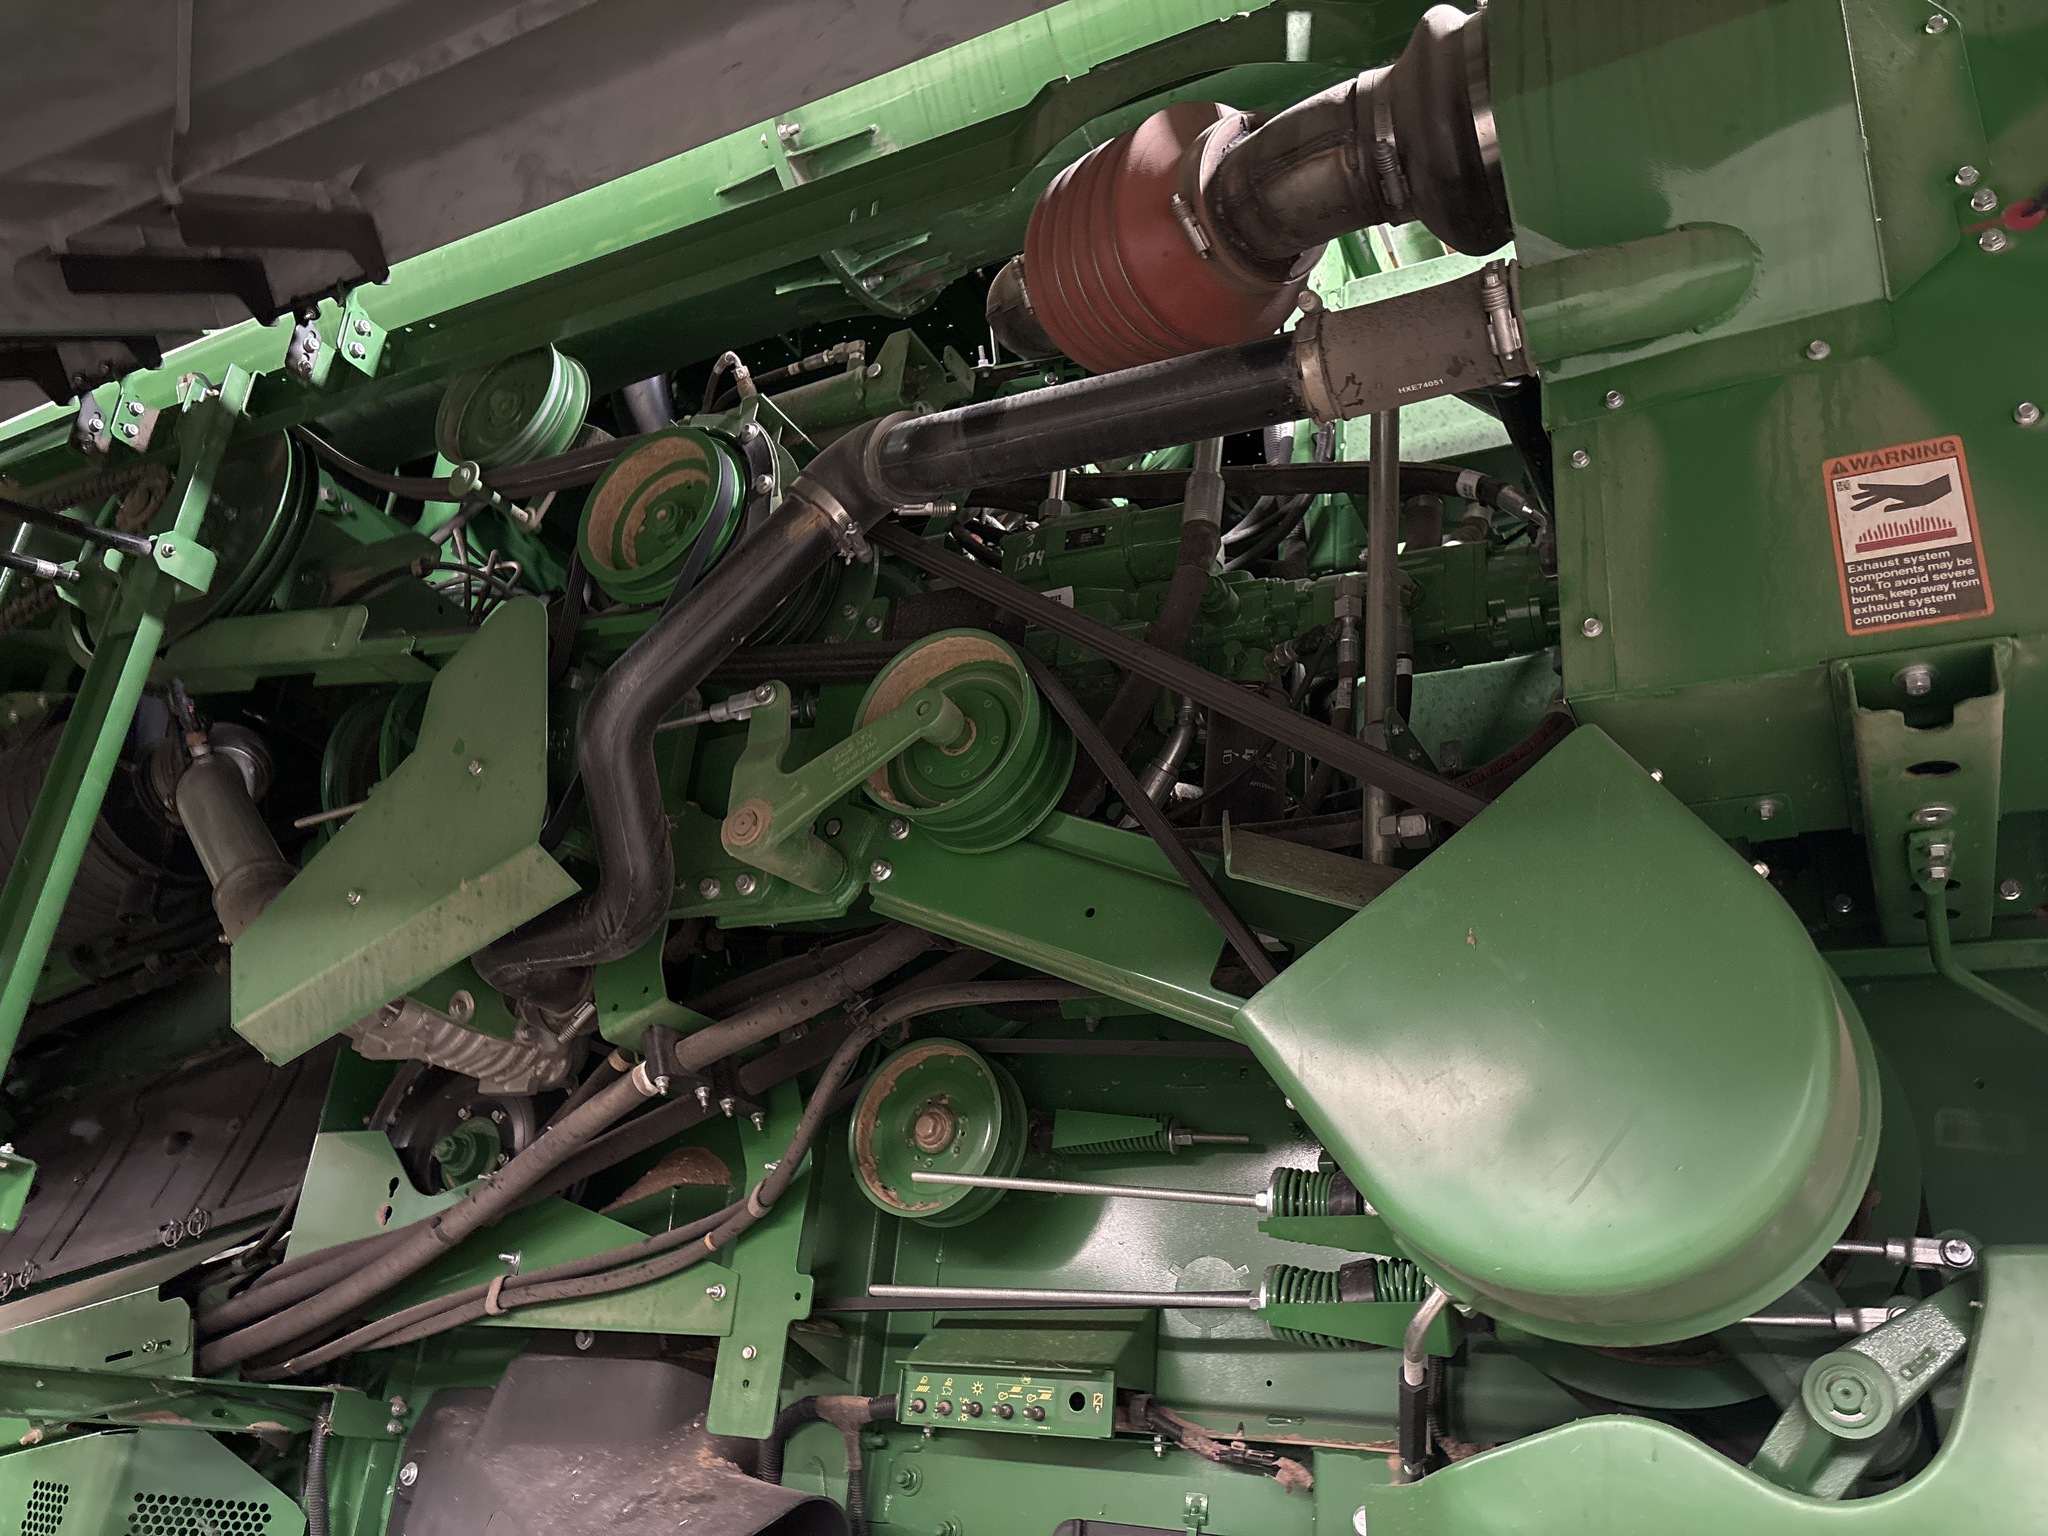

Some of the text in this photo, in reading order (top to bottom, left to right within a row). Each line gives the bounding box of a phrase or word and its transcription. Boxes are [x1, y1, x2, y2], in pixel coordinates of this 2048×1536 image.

[1398, 378, 1444, 394] HXE74051
[1848, 440, 1957, 471] WARNING
[1847, 550, 1951, 574] Exhaust system
[1848, 556, 1974, 585] components may be
[1850, 567, 1976, 595] hot. To avoid severe
[1851, 577, 1981, 605] burns, keep away from
[1853, 592, 1957, 615] exhaust system
[1855, 606, 1941, 626] components.
